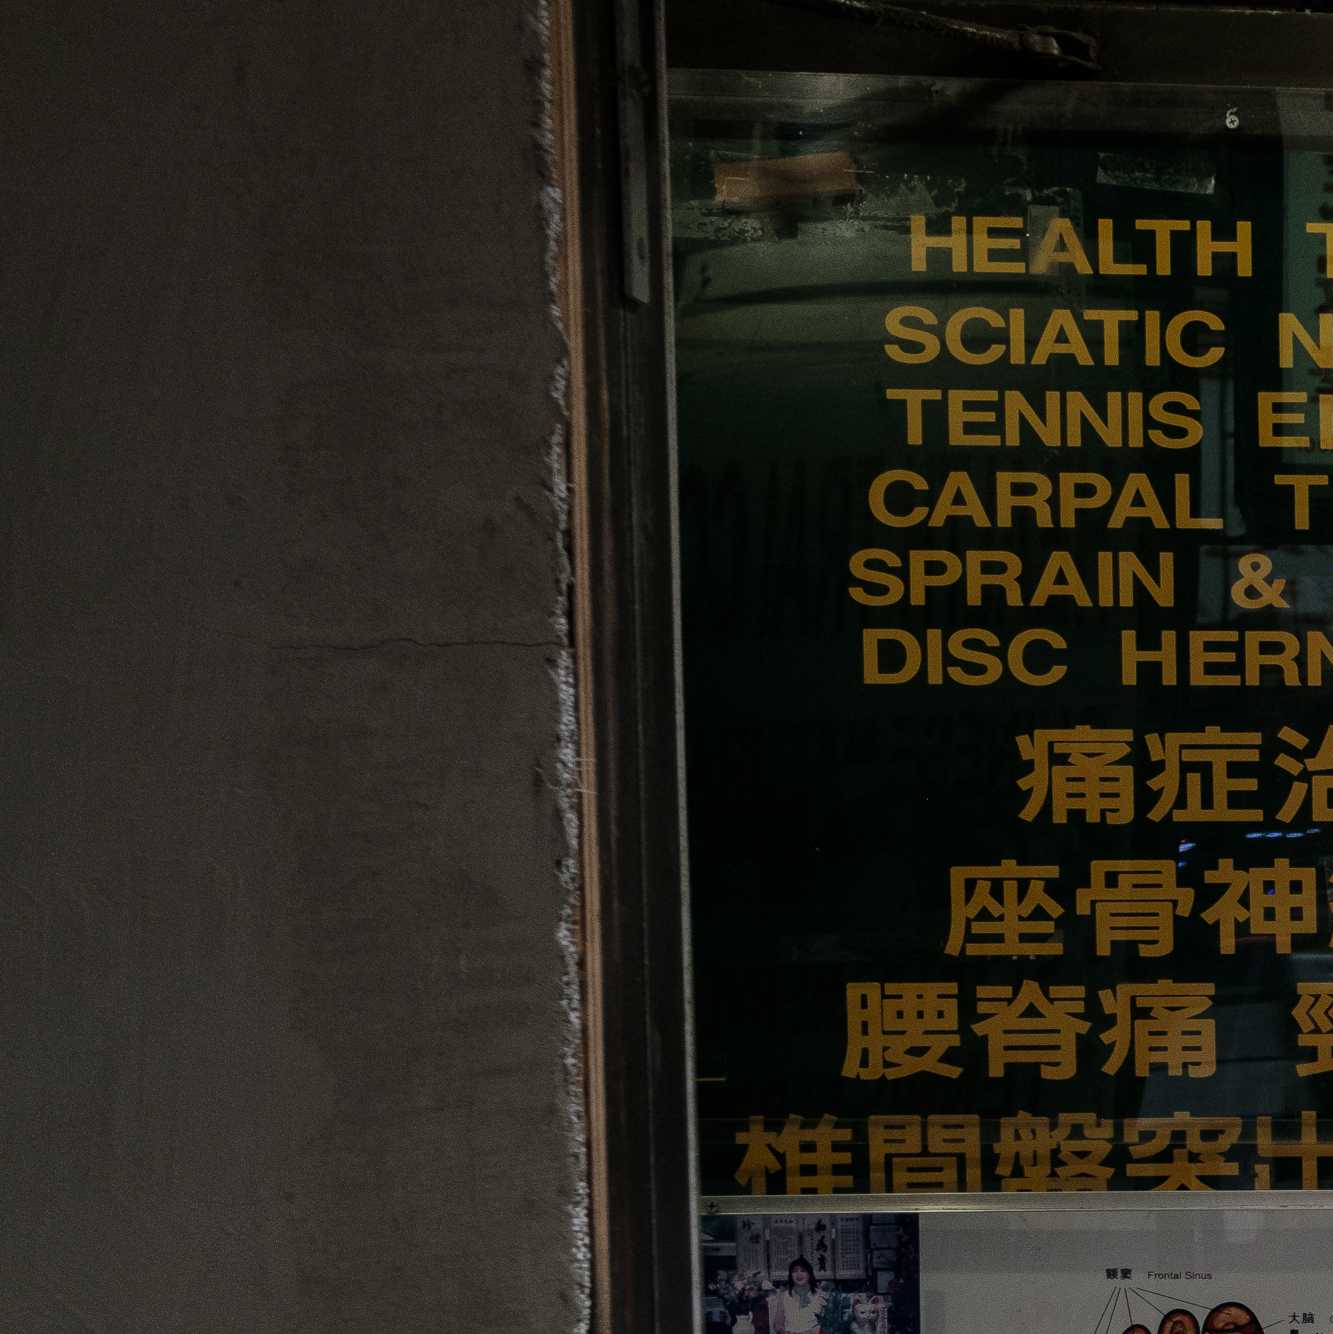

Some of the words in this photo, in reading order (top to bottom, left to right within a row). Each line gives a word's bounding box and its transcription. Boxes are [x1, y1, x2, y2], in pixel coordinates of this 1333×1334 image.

[911, 214, 1252, 277] HEALTH
[884, 305, 1224, 367] SCIATIC
[886, 389, 1203, 449] TENNIS
[869, 471, 1223, 528] CARPAL
[849, 549, 1175, 607] SPRAIN
[1234, 553, 1288, 609] &
[864, 628, 1067, 686] DISC
[842, 980, 1216, 1080] 腰脊痛
[1147, 1271, 1181, 1280] Frontal
[1185, 1271, 1212, 1280] Sinus
